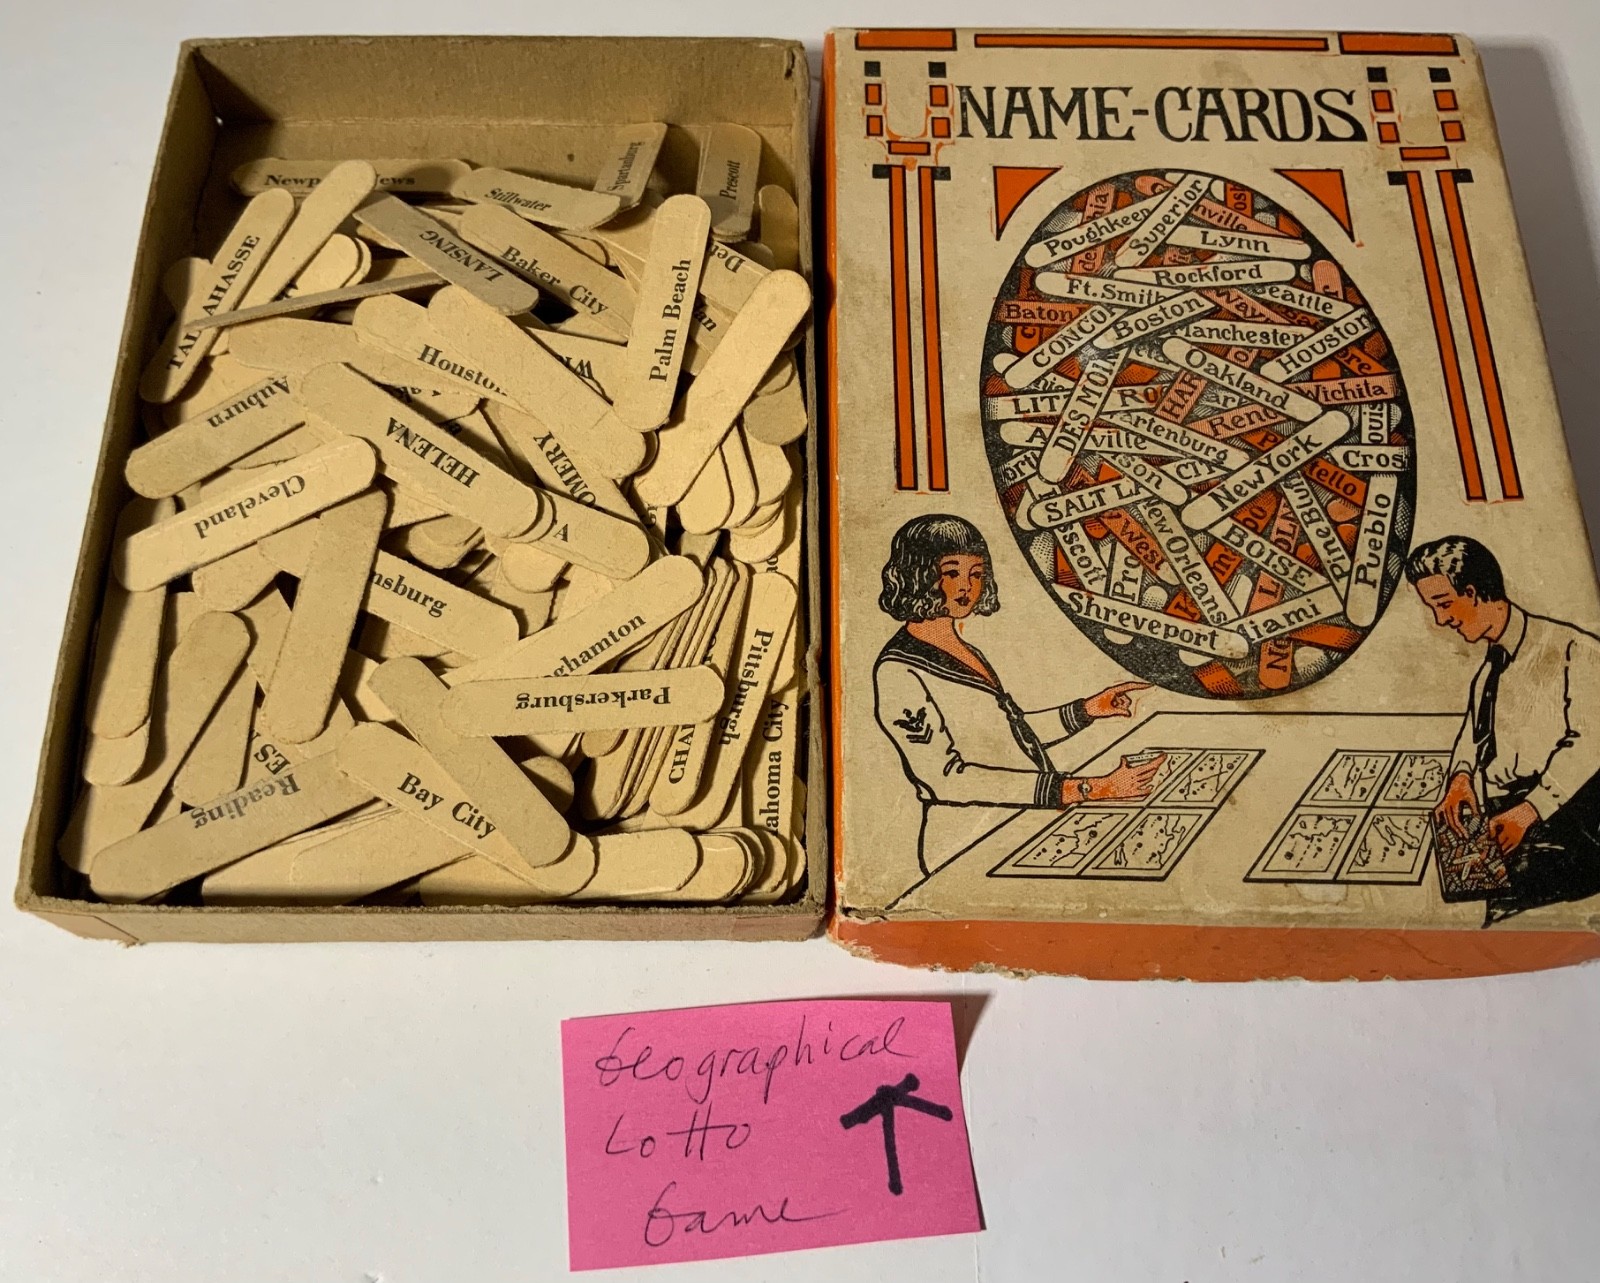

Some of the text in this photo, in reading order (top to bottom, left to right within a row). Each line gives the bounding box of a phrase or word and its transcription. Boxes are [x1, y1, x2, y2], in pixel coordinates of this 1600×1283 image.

[955, 85, 1368, 143] NAME-CARDS
[264, 173, 416, 188] Newp ews
[607, 140, 646, 192] Spartanburg
[719, 160, 741, 201] Prescott
[484, 187, 552, 212] Stillwater
[1129, 179, 1204, 257] Superior
[419, 230, 504, 282] LANSING
[1200, 230, 1271, 253] Lynn
[166, 235, 260, 371] TALAHASSE
[500, 245, 609, 315] Baker City
[1153, 265, 1263, 286] Rockford
[649, 259, 692, 382] Palm Beach
[1112, 297, 1205, 341] Boston
[1276, 313, 1373, 375] Houston
[417, 344, 507, 397] Housto
[1185, 349, 1290, 411] Oakland
[206, 375, 292, 428] Auburn
[385, 417, 481, 489] HELENA
[1052, 410, 1091, 455] DES
[193, 475, 306, 539] Cleveland
[1045, 489, 1109, 522] SALT
[1221, 524, 1314, 586] BOISE
[1355, 492, 1391, 589] Pueblo
[1166, 536, 1228, 626] Orleans
[543, 612, 647, 678] ghamton
[1068, 591, 1220, 651] Shreveport
[515, 686, 672, 712] Parkersburg
[719, 628, 775, 746] Pittsburgh
[762, 700, 790, 742] City
[191, 772, 301, 829] Reading
[397, 772, 497, 840] Bay City
[595, 1015, 918, 1104] Geographical
[605, 1101, 751, 1161] Lotto
[643, 1181, 852, 1248] Game
